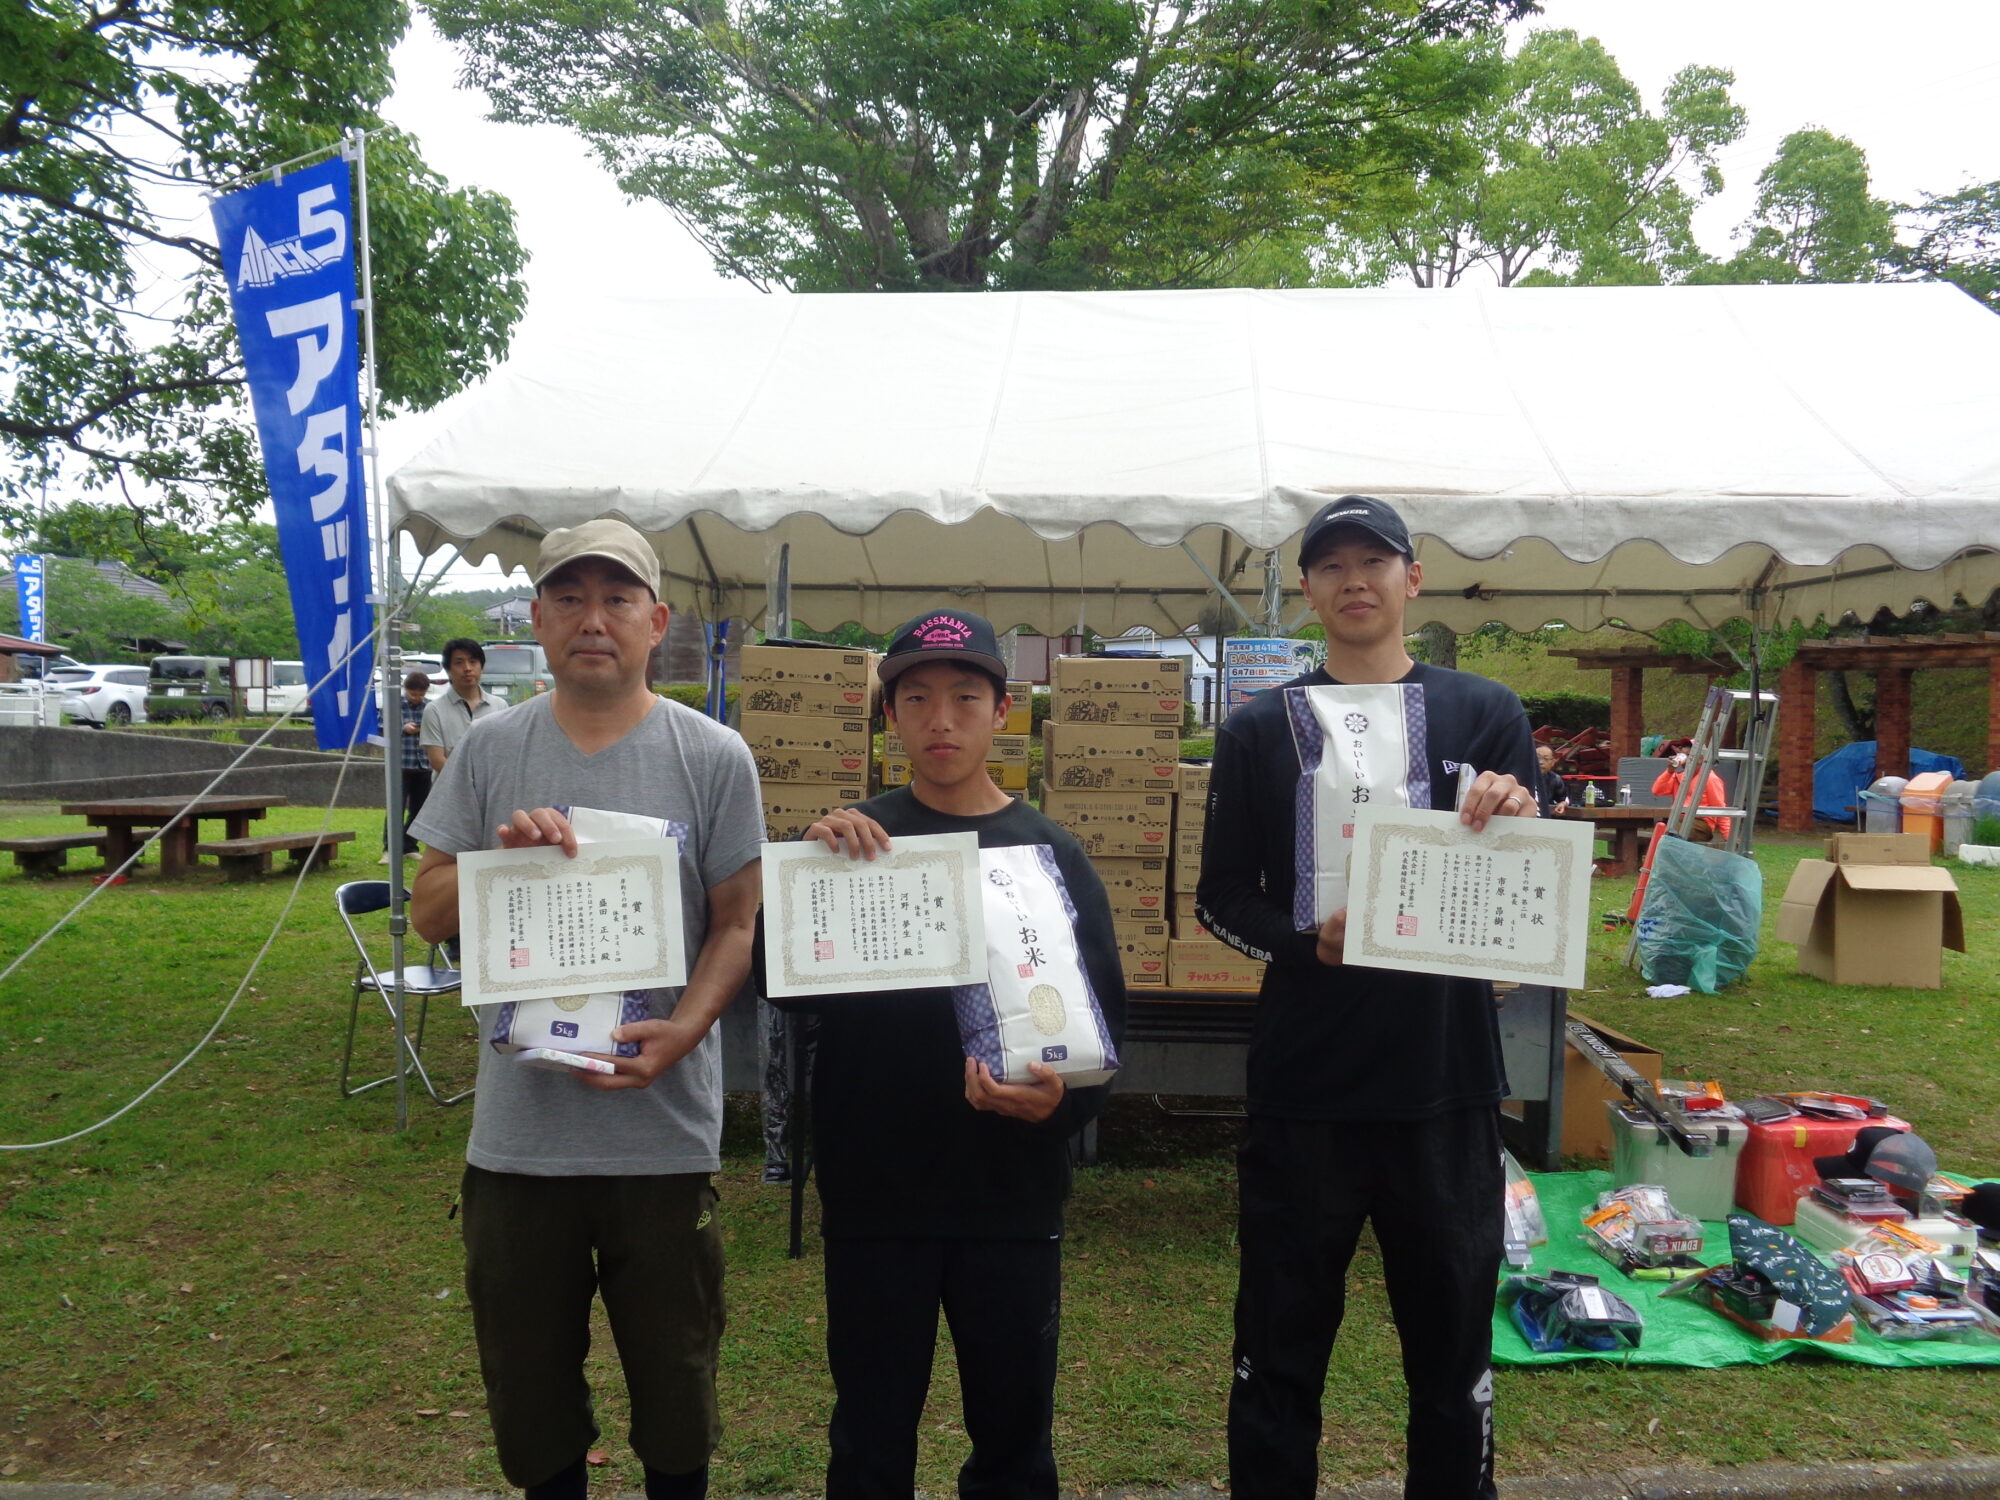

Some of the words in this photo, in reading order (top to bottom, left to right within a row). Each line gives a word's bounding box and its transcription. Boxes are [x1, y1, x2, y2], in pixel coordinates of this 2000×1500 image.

[1327, 510, 1350, 520] NEW
[913, 615, 972, 638] BASSMANIA
[1353, 740, 1365, 780] おいしい
[1410, 850, 1418, 876] 株式会社
[1496, 876, 1506, 896] 市原
[600, 899, 608, 916] 盛田
[901, 893, 910, 911] 河野
[902, 920, 911, 938] 夢生
[1005, 890, 1028, 922] おいしい
[1018, 926, 1047, 968] お米
[1492, 936, 1502, 946] 殿
[904, 948, 912, 956] 殿
[556, 1023, 573, 1037] 5kg
[1046, 1048, 1063, 1060] 5kg
[1671, 1239, 1699, 1253] EDWIN
